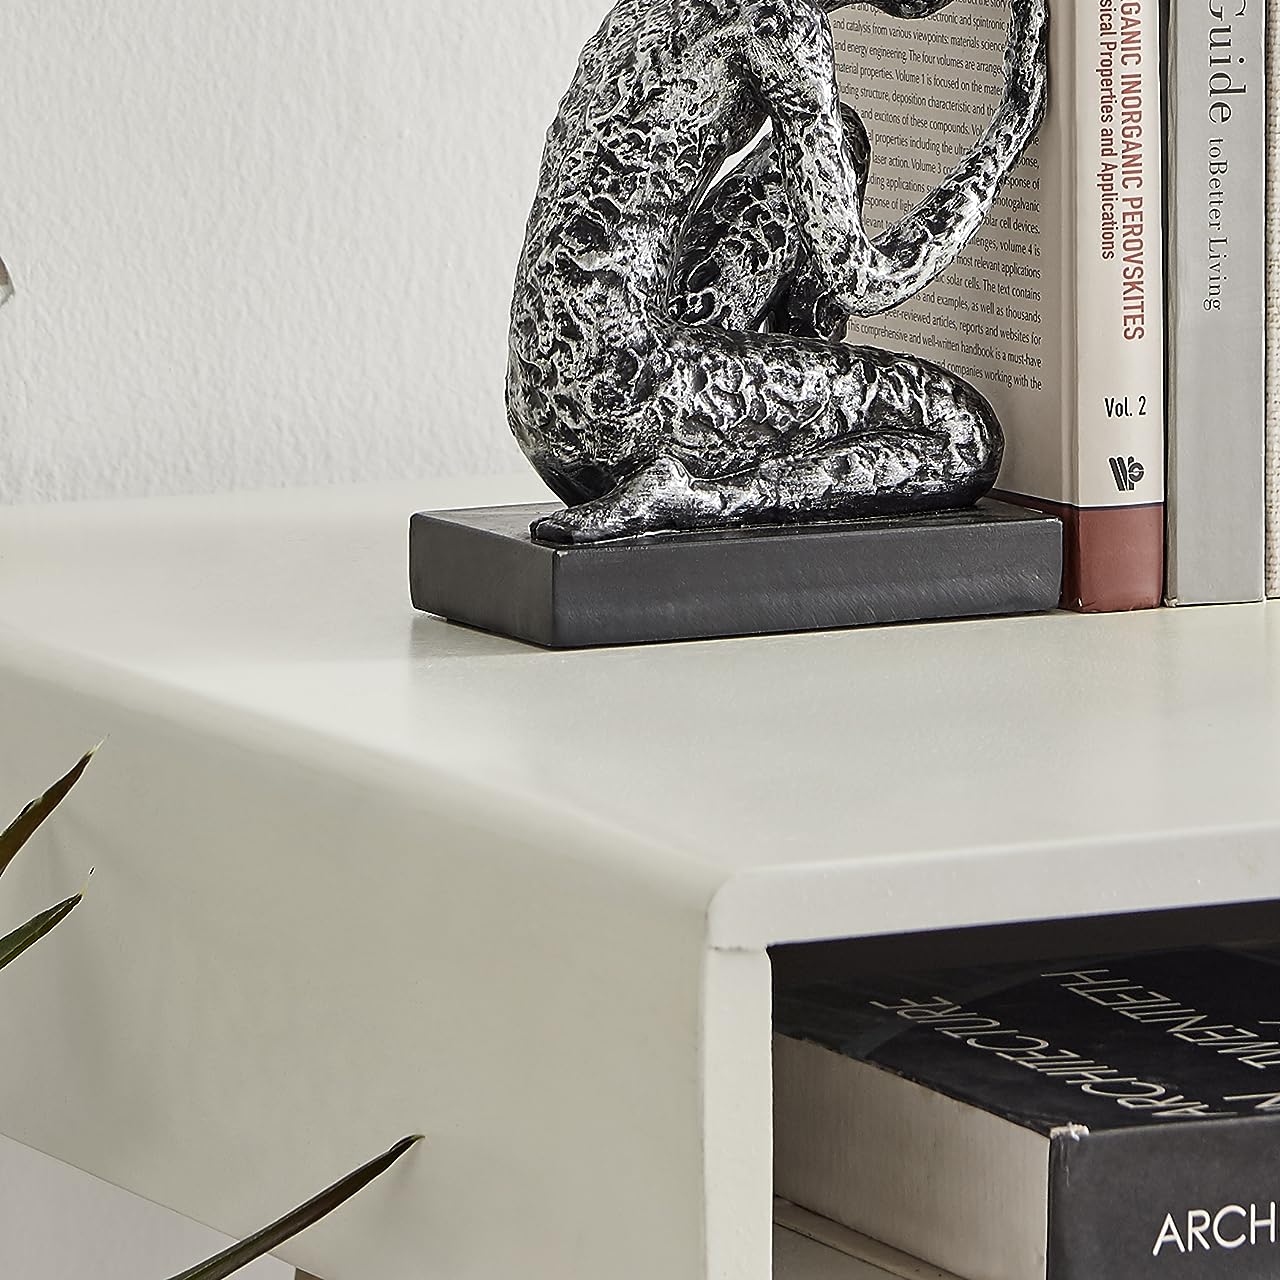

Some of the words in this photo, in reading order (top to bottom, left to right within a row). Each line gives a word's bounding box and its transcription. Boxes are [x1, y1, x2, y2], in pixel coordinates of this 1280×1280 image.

[833, 18, 845, 31] and
[846, 20, 872, 36] catalysis
[872, 22, 888, 36] from
[889, 26, 913, 40] various
[950, 36, 980, 50] materials
[959, 13, 972, 27] and
[973, 15, 1006, 32] spintronic
[834, 40, 846, 52] and
[847, 43, 869, 58] energy
[909, 49, 921, 63] The
[922, 51, 936, 65] four
[936, 54, 965, 70] volumes
[965, 60, 976, 71] are
[895, 69, 920, 84] Volume
[934, 74, 961, 90] focused
[961, 80, 971, 91] on
[971, 80, 984, 94] the
[1095, 41, 1118, 125] Properties
[861, 87, 890, 102] structure,
[892, 90, 928, 107] deposition
[928, 96, 972, 115] characteristic
[973, 103, 986, 116] and
[861, 108, 873, 121] and
[874, 111, 901, 125] excitons
[902, 113, 911, 126] of
[911, 114, 929, 129] these
[930, 119, 971, 136] compounds.
[1120, 72, 1144, 191] INORGANIC
[875, 133, 909, 148] properties
[910, 135, 941, 157] including
[942, 141, 954, 155] the
[1100, 127, 1118, 159] and
[888, 155, 911, 169] action.
[911, 158, 937, 175] Volume
[886, 176, 926, 194] applications
[1032, 178, 1040, 191] of
[891, 198, 900, 211] of
[1096, 162, 1119, 261] Applications
[1000, 217, 1011, 230] cell
[1013, 218, 1041, 235] devices.
[1000, 238, 1027, 255] volume
[956, 255, 973, 268] most
[974, 256, 1001, 273] relevant
[1001, 262, 1041, 280] applications
[1121, 196, 1146, 342] PEROVSKITES
[1202, 237, 1229, 312] Living
[946, 273, 963, 287] solar
[964, 276, 981, 291] cells.
[982, 278, 996, 294] The
[997, 282, 1010, 296] text
[1011, 287, 1041, 302] contains
[922, 291, 935, 305] and
[936, 295, 970, 312] examples,
[971, 301, 979, 312] as
[980, 302, 995, 316] well
[996, 306, 1004, 318] as
[1005, 305, 1042, 325] thousands
[932, 314, 958, 331] articles,
[959, 321, 984, 337] reports
[985, 325, 999, 338] and
[999, 328, 1031, 344] websites
[1031, 331, 1042, 346] for
[860, 323, 908, 342] comprehensive
[909, 332, 921, 345] and
[921, 334, 960, 353] well-written
[961, 340, 994, 360] handbook
[1007, 352, 1042, 369] must-have
[984, 369, 1014, 389] working
[1013, 374, 1030, 389] with
[1030, 376, 1042, 391] the
[1104, 396, 1133, 418] Vol.
[1138, 395, 1147, 416] 2
[869, 995, 1238, 1118] ARCHITECTURE
